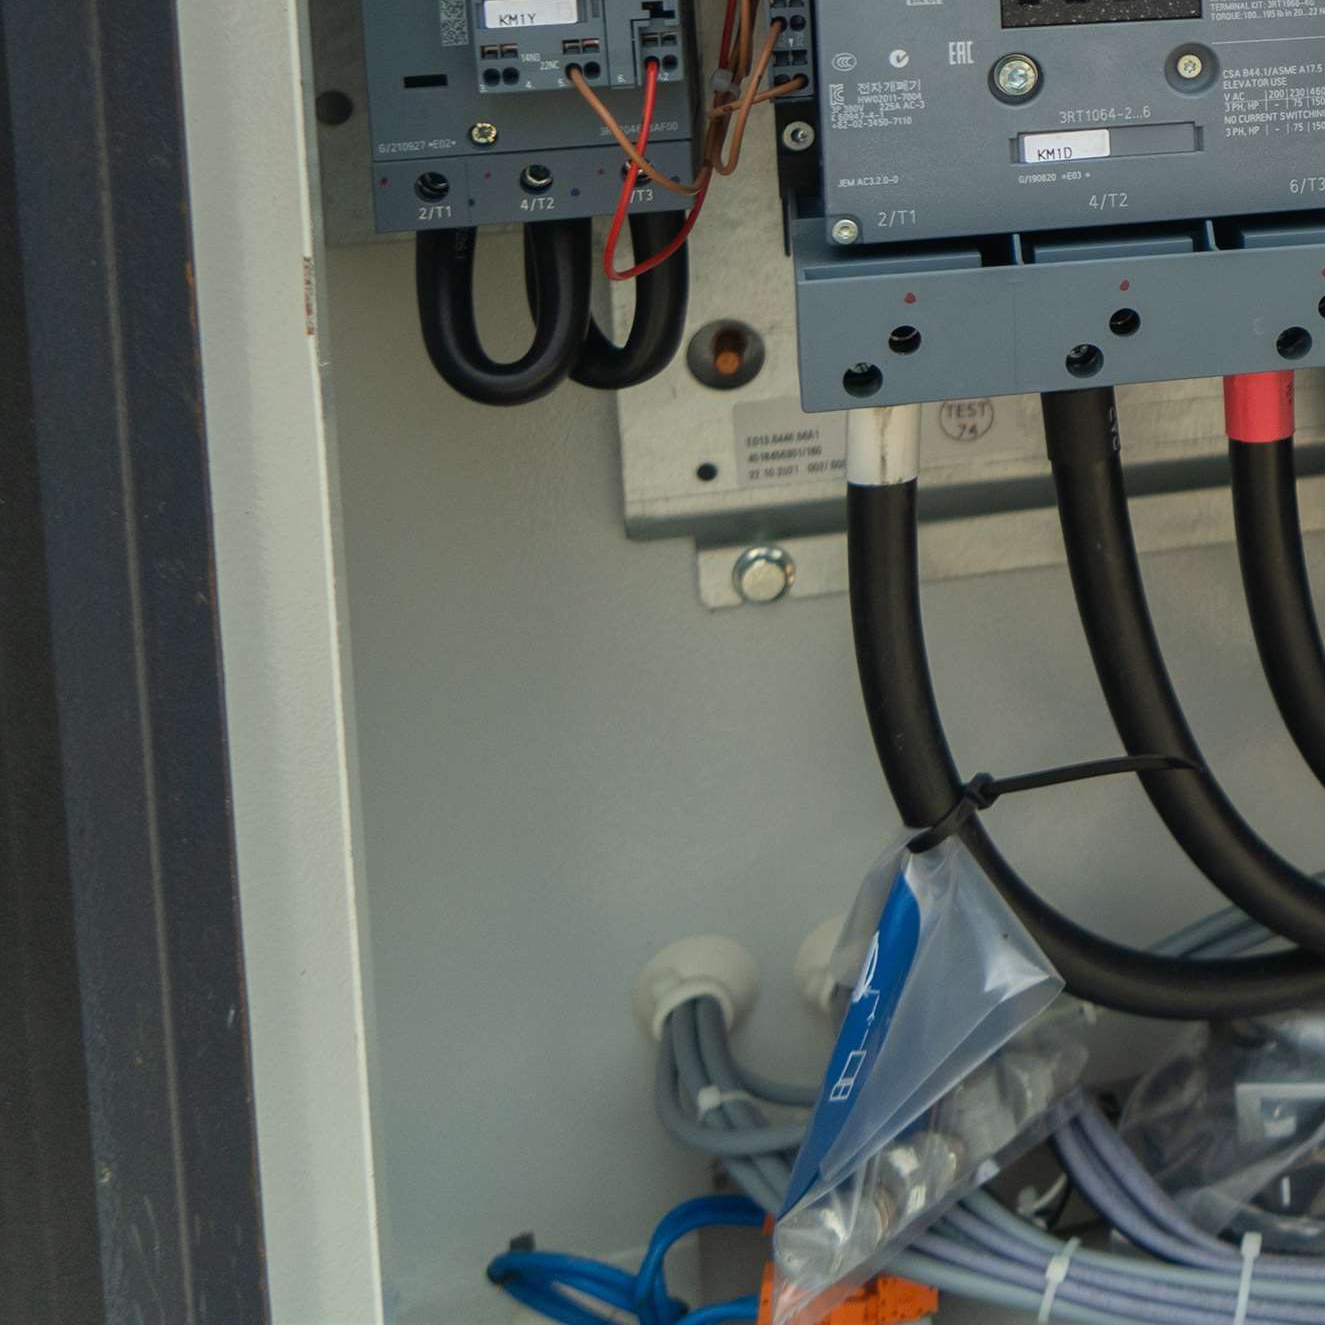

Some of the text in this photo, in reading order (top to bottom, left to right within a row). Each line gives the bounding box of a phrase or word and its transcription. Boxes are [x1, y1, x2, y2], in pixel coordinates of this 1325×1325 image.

[500, 14, 536, 25] KM1Y
[1299, 64, 1322, 73] A17.5
[1223, 77, 1287, 89] ELEVATOR USE
[1233, 92, 1244, 101] AC
[1269, 89, 1285, 99] 200
[1038, 147, 1072, 160] KM1D
[419, 190, 653, 220] 2/T1 4/T2 /T3
[878, 210, 917, 227] 2/T1
[1089, 193, 1129, 209] 4/T2
